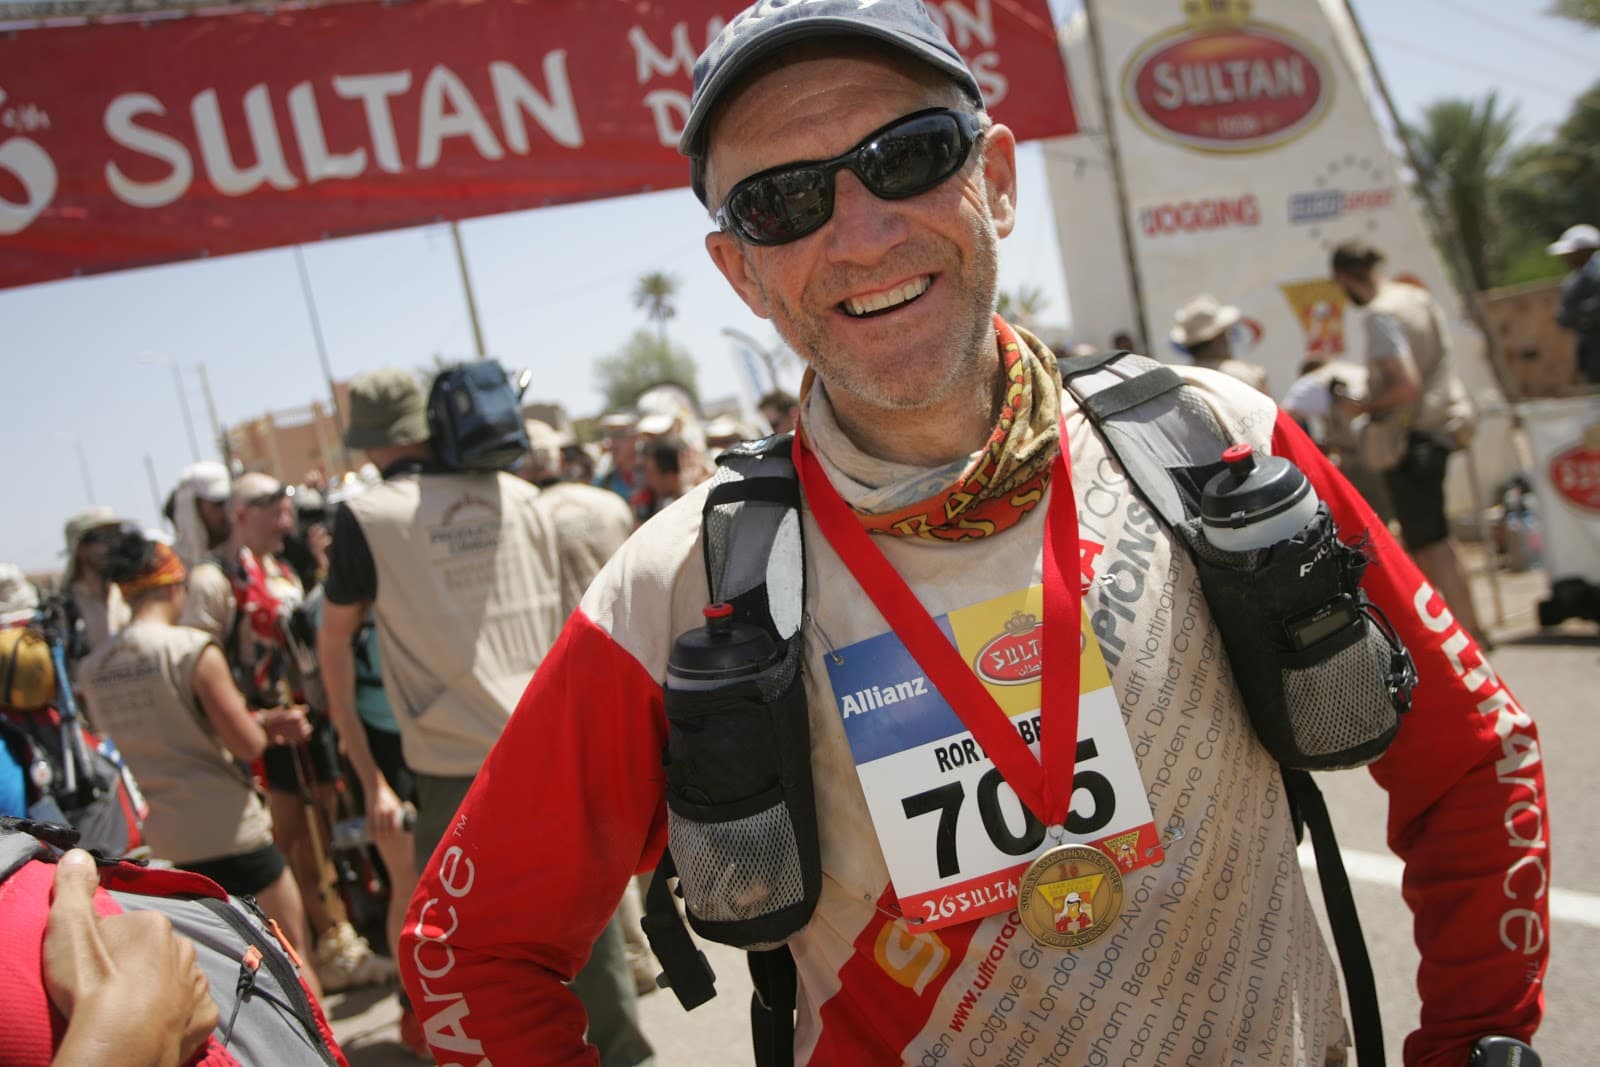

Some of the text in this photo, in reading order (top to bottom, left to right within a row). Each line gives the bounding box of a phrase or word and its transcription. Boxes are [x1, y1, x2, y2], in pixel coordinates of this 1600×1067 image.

[1153, 53, 1306, 111] SULTAN
[104, 49, 585, 209] SULTAN
[990, 638, 1041, 671] SULT
[842, 676, 929, 719] Allianz
[1120, 669, 1147, 726] ardiff
[934, 738, 989, 773] ROR
[901, 737, 1117, 880] 705
[1185, 907, 1222, 987] Brecon
[1213, 825, 1243, 902] Cardiff
[949, 910, 1022, 1033] www.ultrarac
[1120, 918, 1171, 997] Brecon
[969, 974, 1028, 1058] Cotgrave
[1232, 975, 1263, 1054] Brecon
